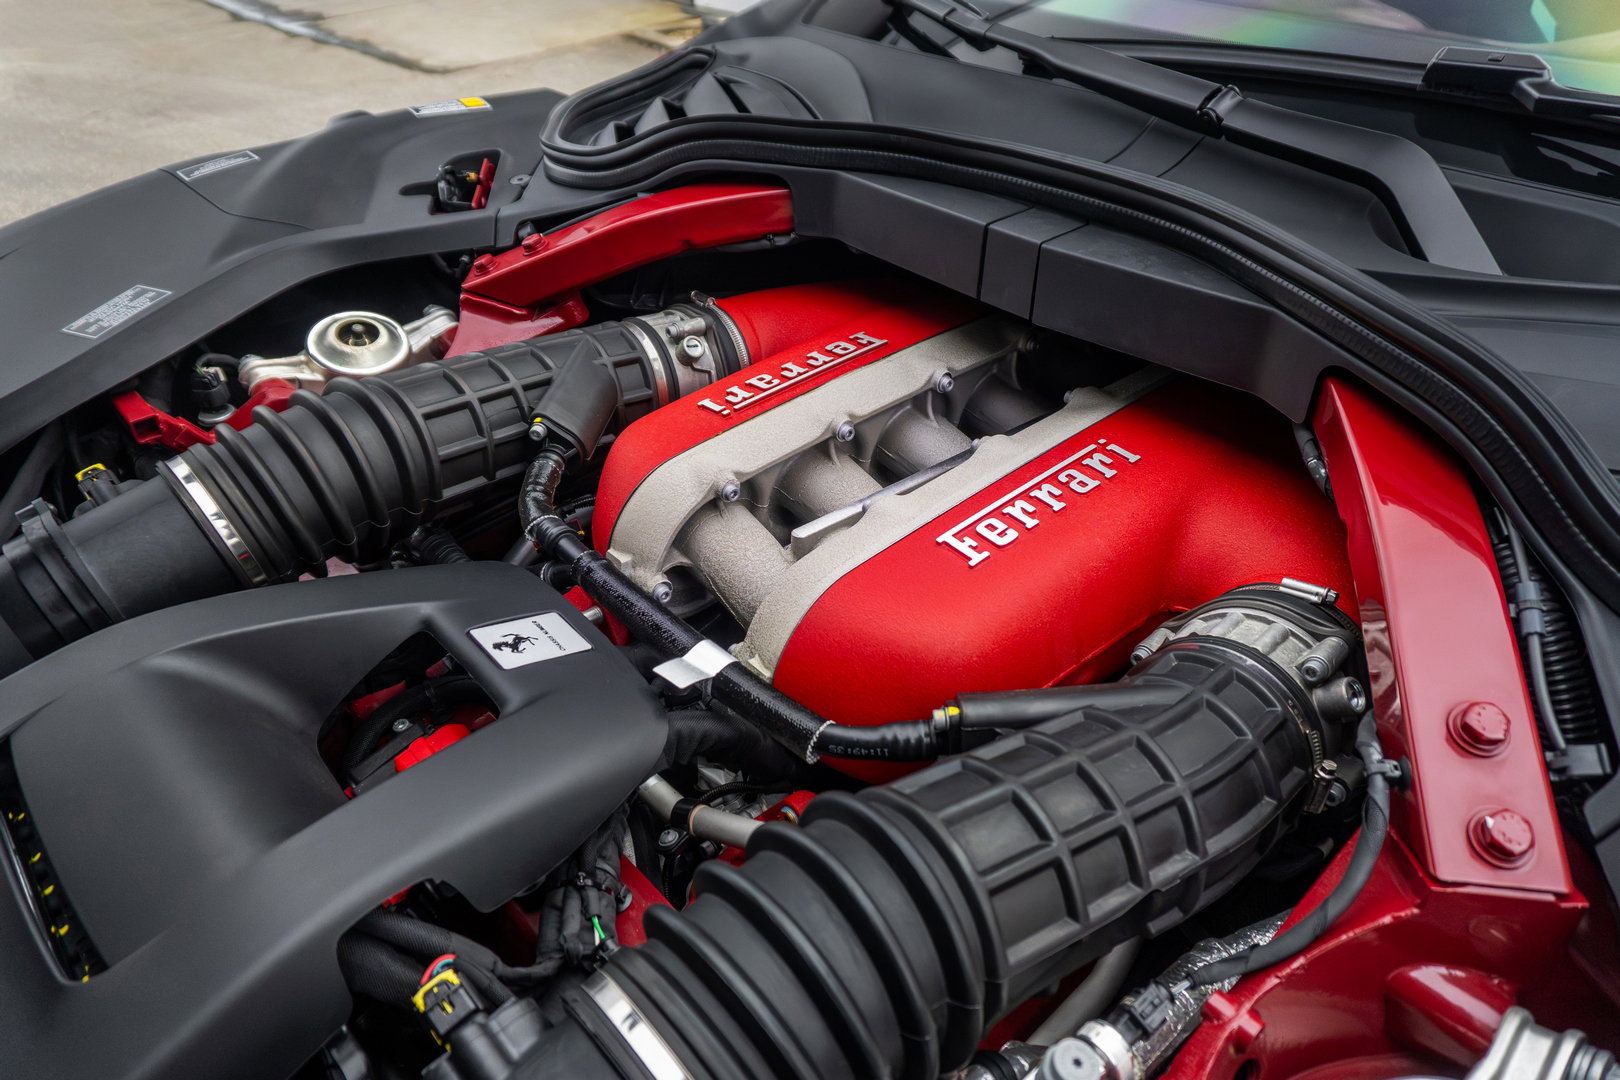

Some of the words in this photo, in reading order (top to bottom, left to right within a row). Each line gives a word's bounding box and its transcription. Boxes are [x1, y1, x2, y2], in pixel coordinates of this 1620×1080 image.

[697, 331, 888, 417] Ferrari
[935, 438, 1141, 567] Ferrari
[531, 620, 549, 635] NUMBER
[546, 635, 566, 651] CHASSIS
